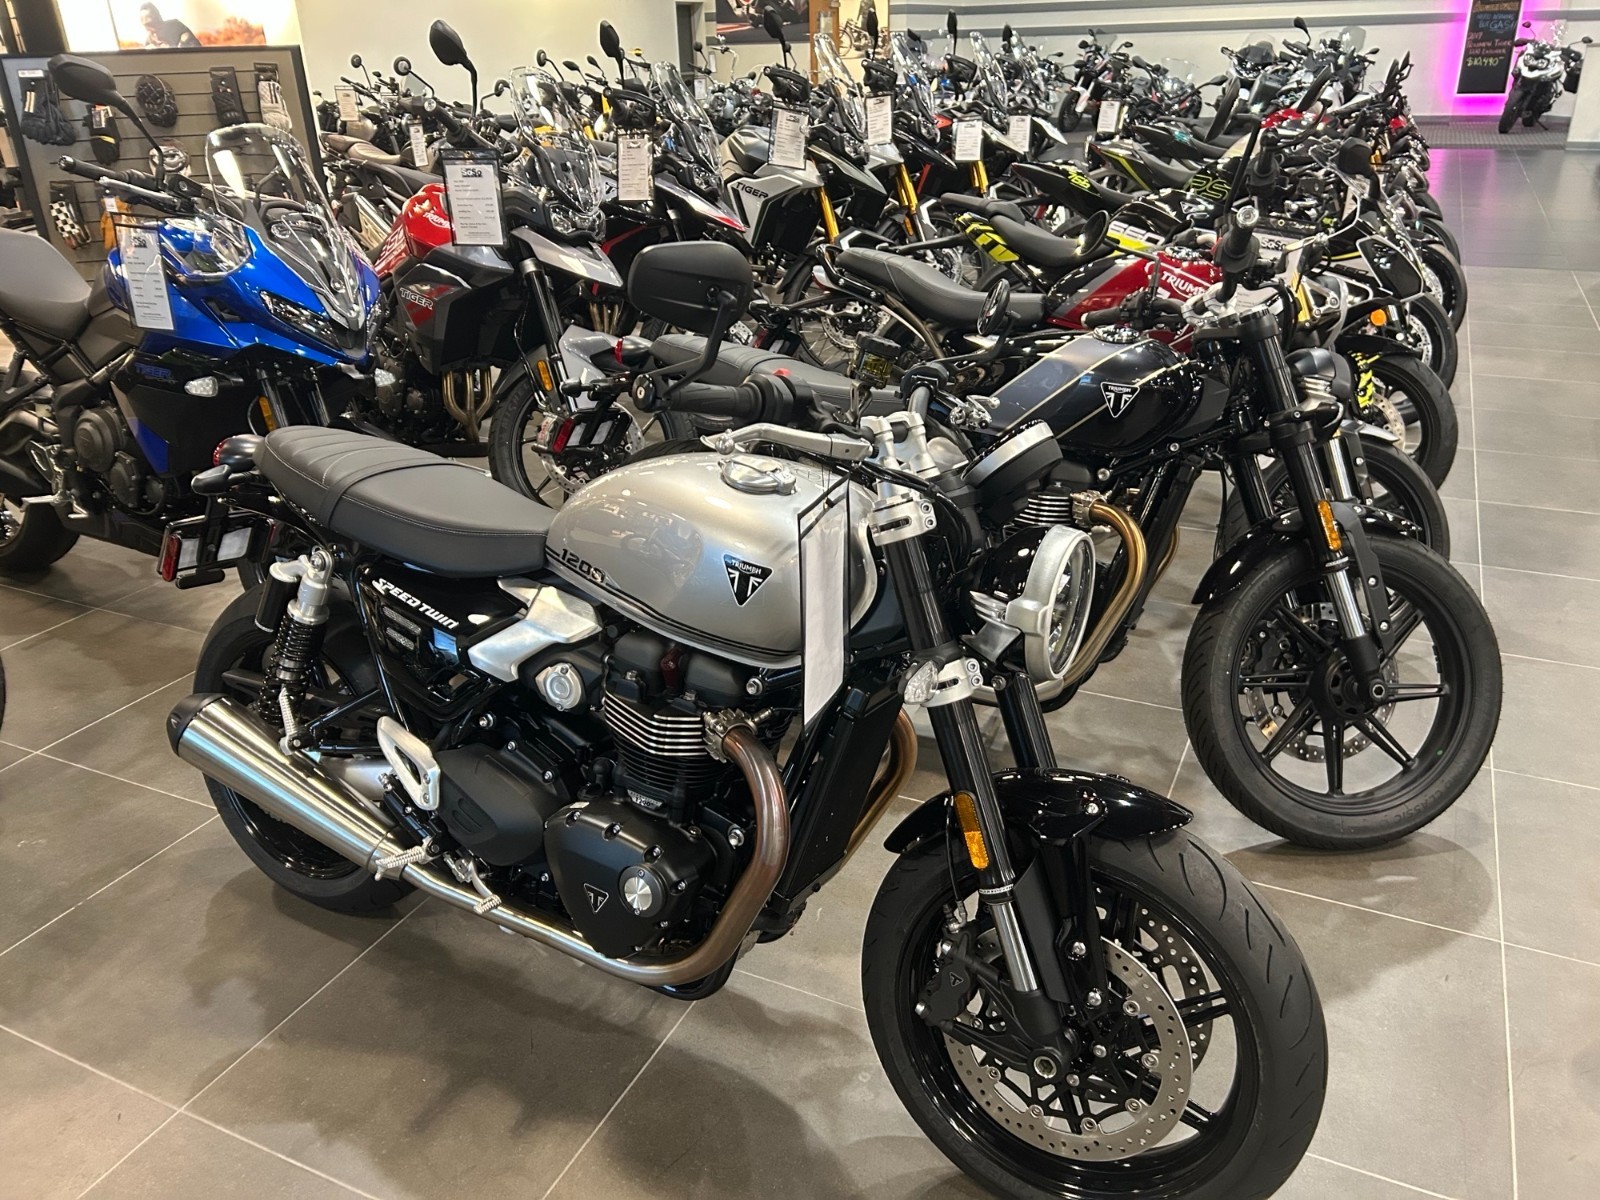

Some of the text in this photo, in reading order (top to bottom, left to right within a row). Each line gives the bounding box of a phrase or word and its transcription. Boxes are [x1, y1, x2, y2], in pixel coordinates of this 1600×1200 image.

[736, 181, 769, 199] TIGER
[1161, 270, 1206, 297] TRIUMP
[400, 287, 434, 310] TIGER
[1108, 385, 1132, 394] TRIUMPH
[731, 559, 762, 575] TRIUMPH
[372, 578, 459, 630] SPEED TWIN
